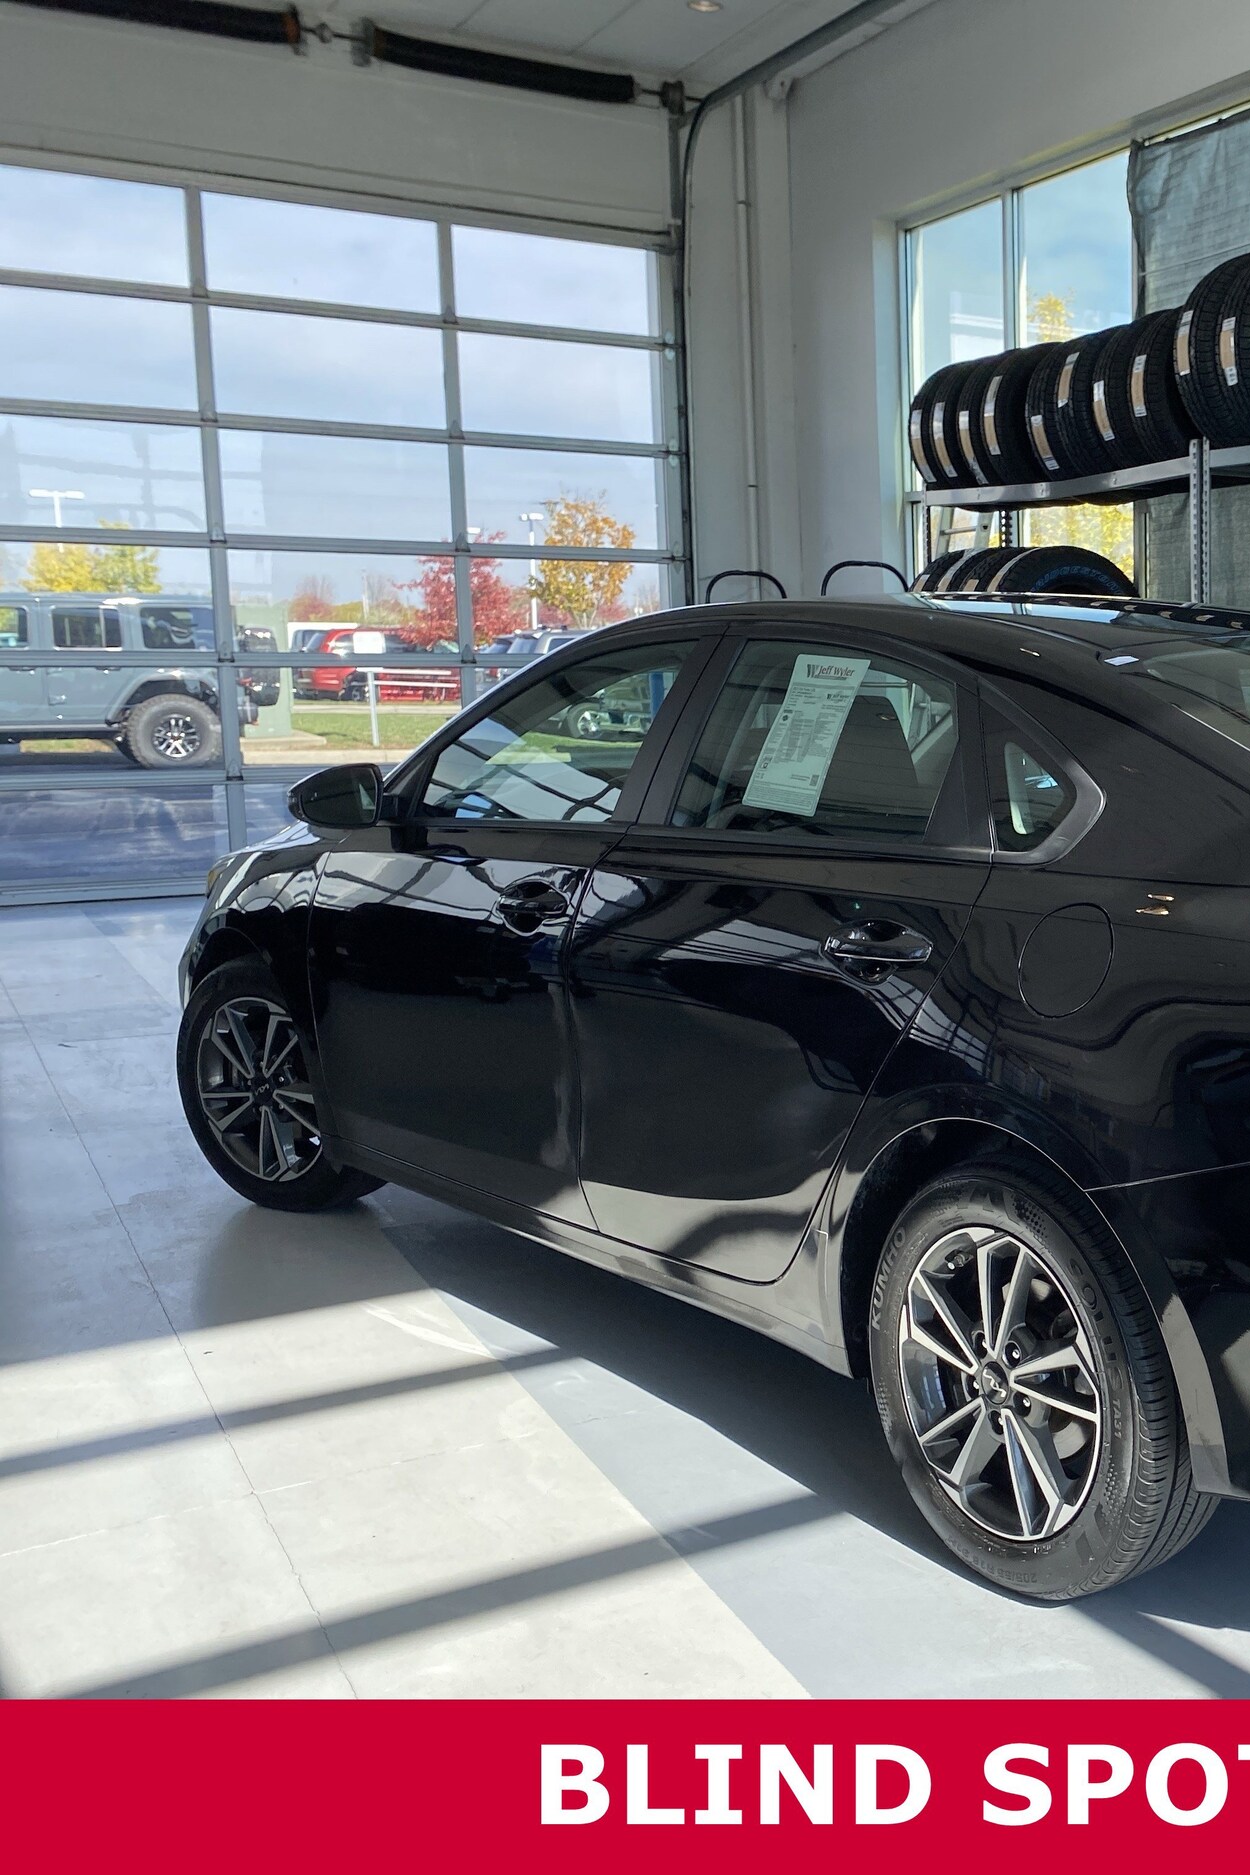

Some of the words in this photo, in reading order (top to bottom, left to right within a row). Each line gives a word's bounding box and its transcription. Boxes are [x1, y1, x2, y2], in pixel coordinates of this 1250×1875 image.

[818, 665, 835, 676] Jeff
[834, 666, 855, 677] Wyler
[871, 1226, 906, 1331] KUMHO
[1068, 1256, 1125, 1391] SOLUS
[1111, 1400, 1123, 1440] TA31
